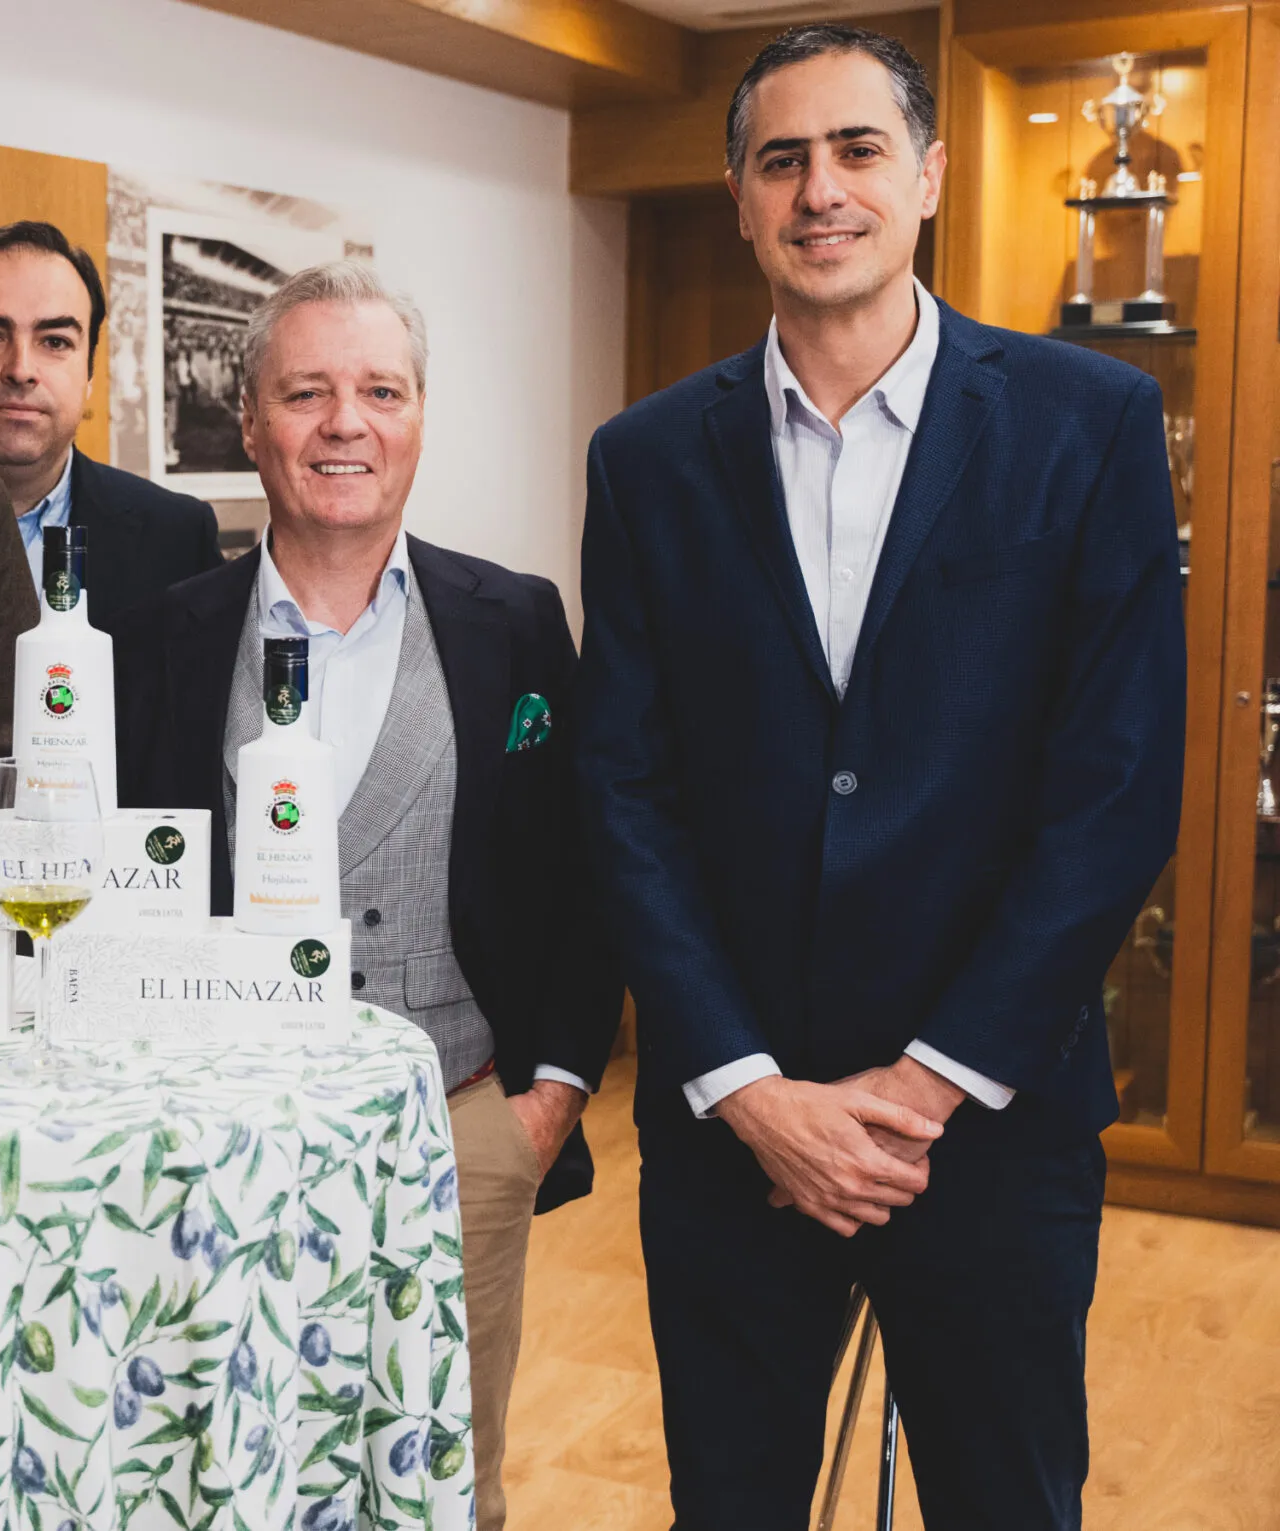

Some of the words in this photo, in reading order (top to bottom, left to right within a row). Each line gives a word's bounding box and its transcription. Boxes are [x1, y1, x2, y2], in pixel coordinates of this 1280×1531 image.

[2, 859, 34, 880] EL
[69, 968, 79, 1003] BAENA
[140, 977, 174, 1000] EL
[182, 978, 325, 1003] HENAZAR
